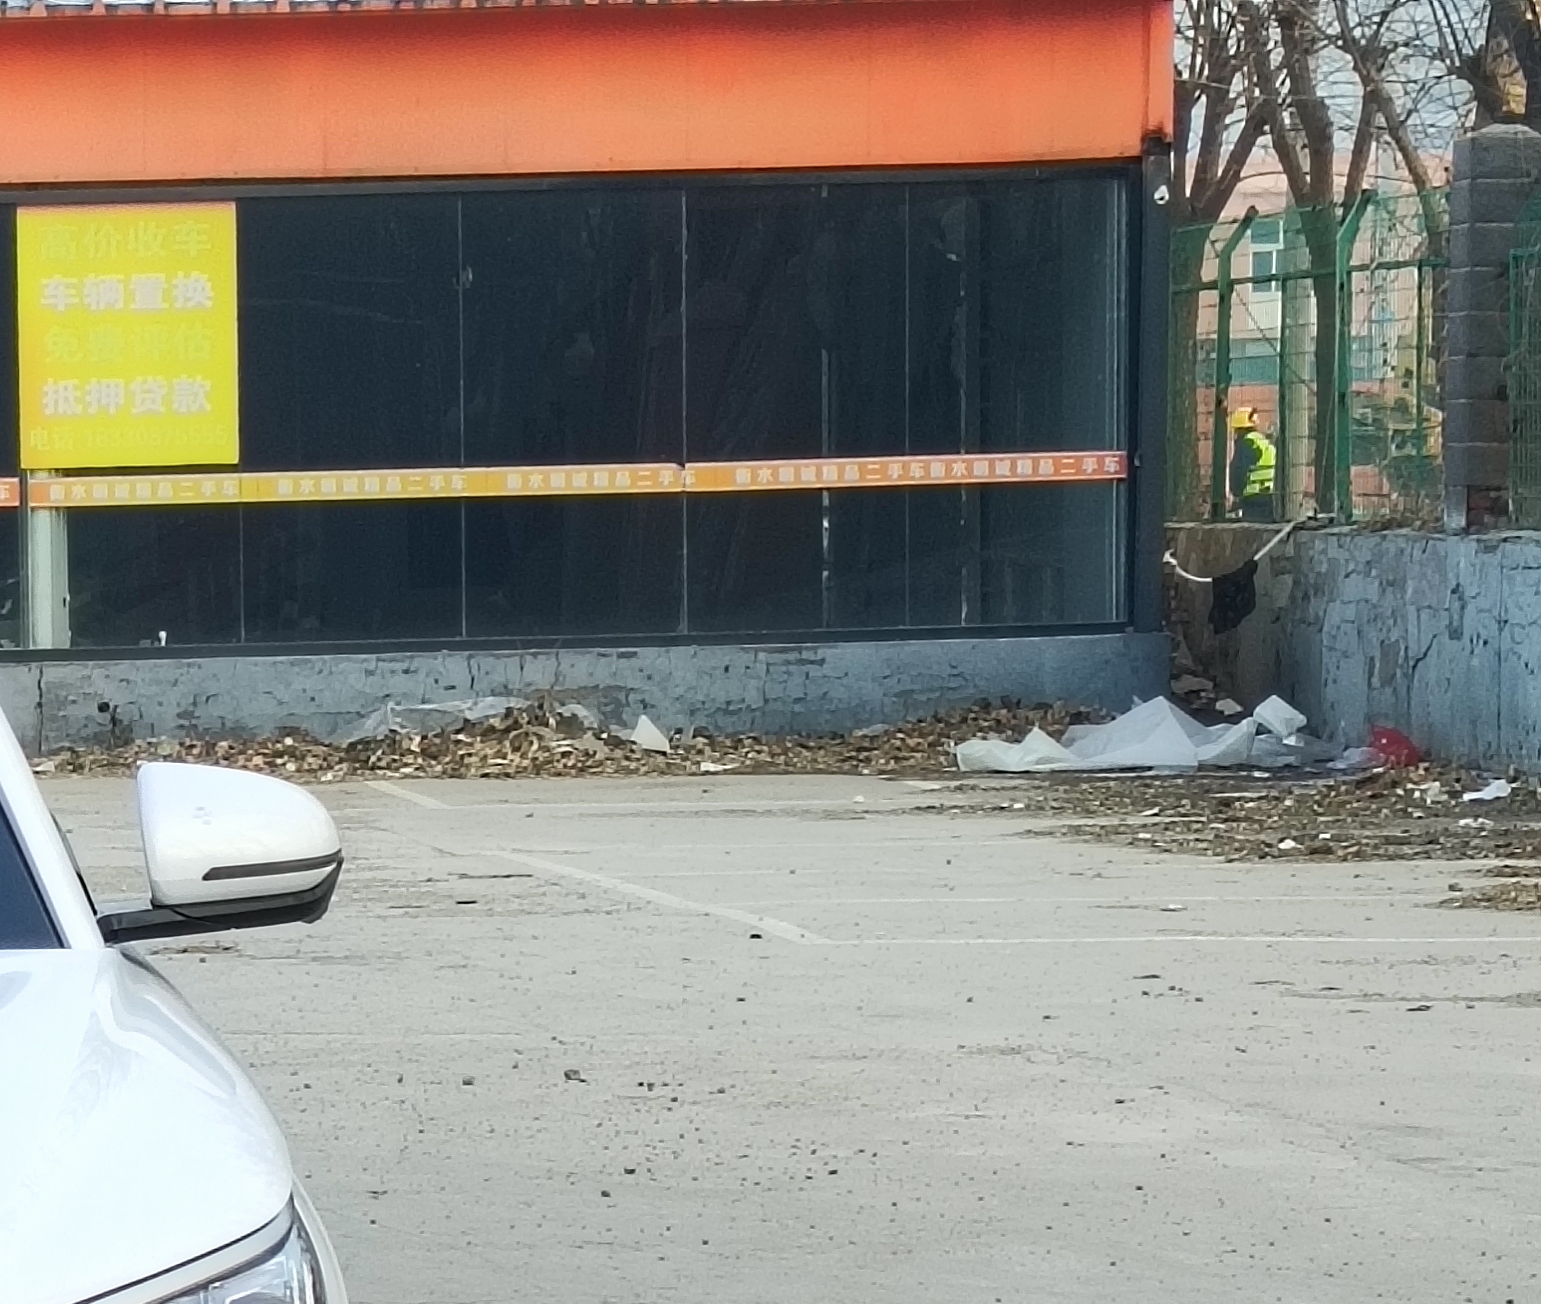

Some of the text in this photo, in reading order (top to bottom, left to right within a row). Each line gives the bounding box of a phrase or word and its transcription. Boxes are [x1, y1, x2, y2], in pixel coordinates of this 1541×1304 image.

[39, 220, 212, 261] 高价收车
[40, 271, 215, 312] 车辆置换
[42, 376, 211, 416] 抵押贷款
